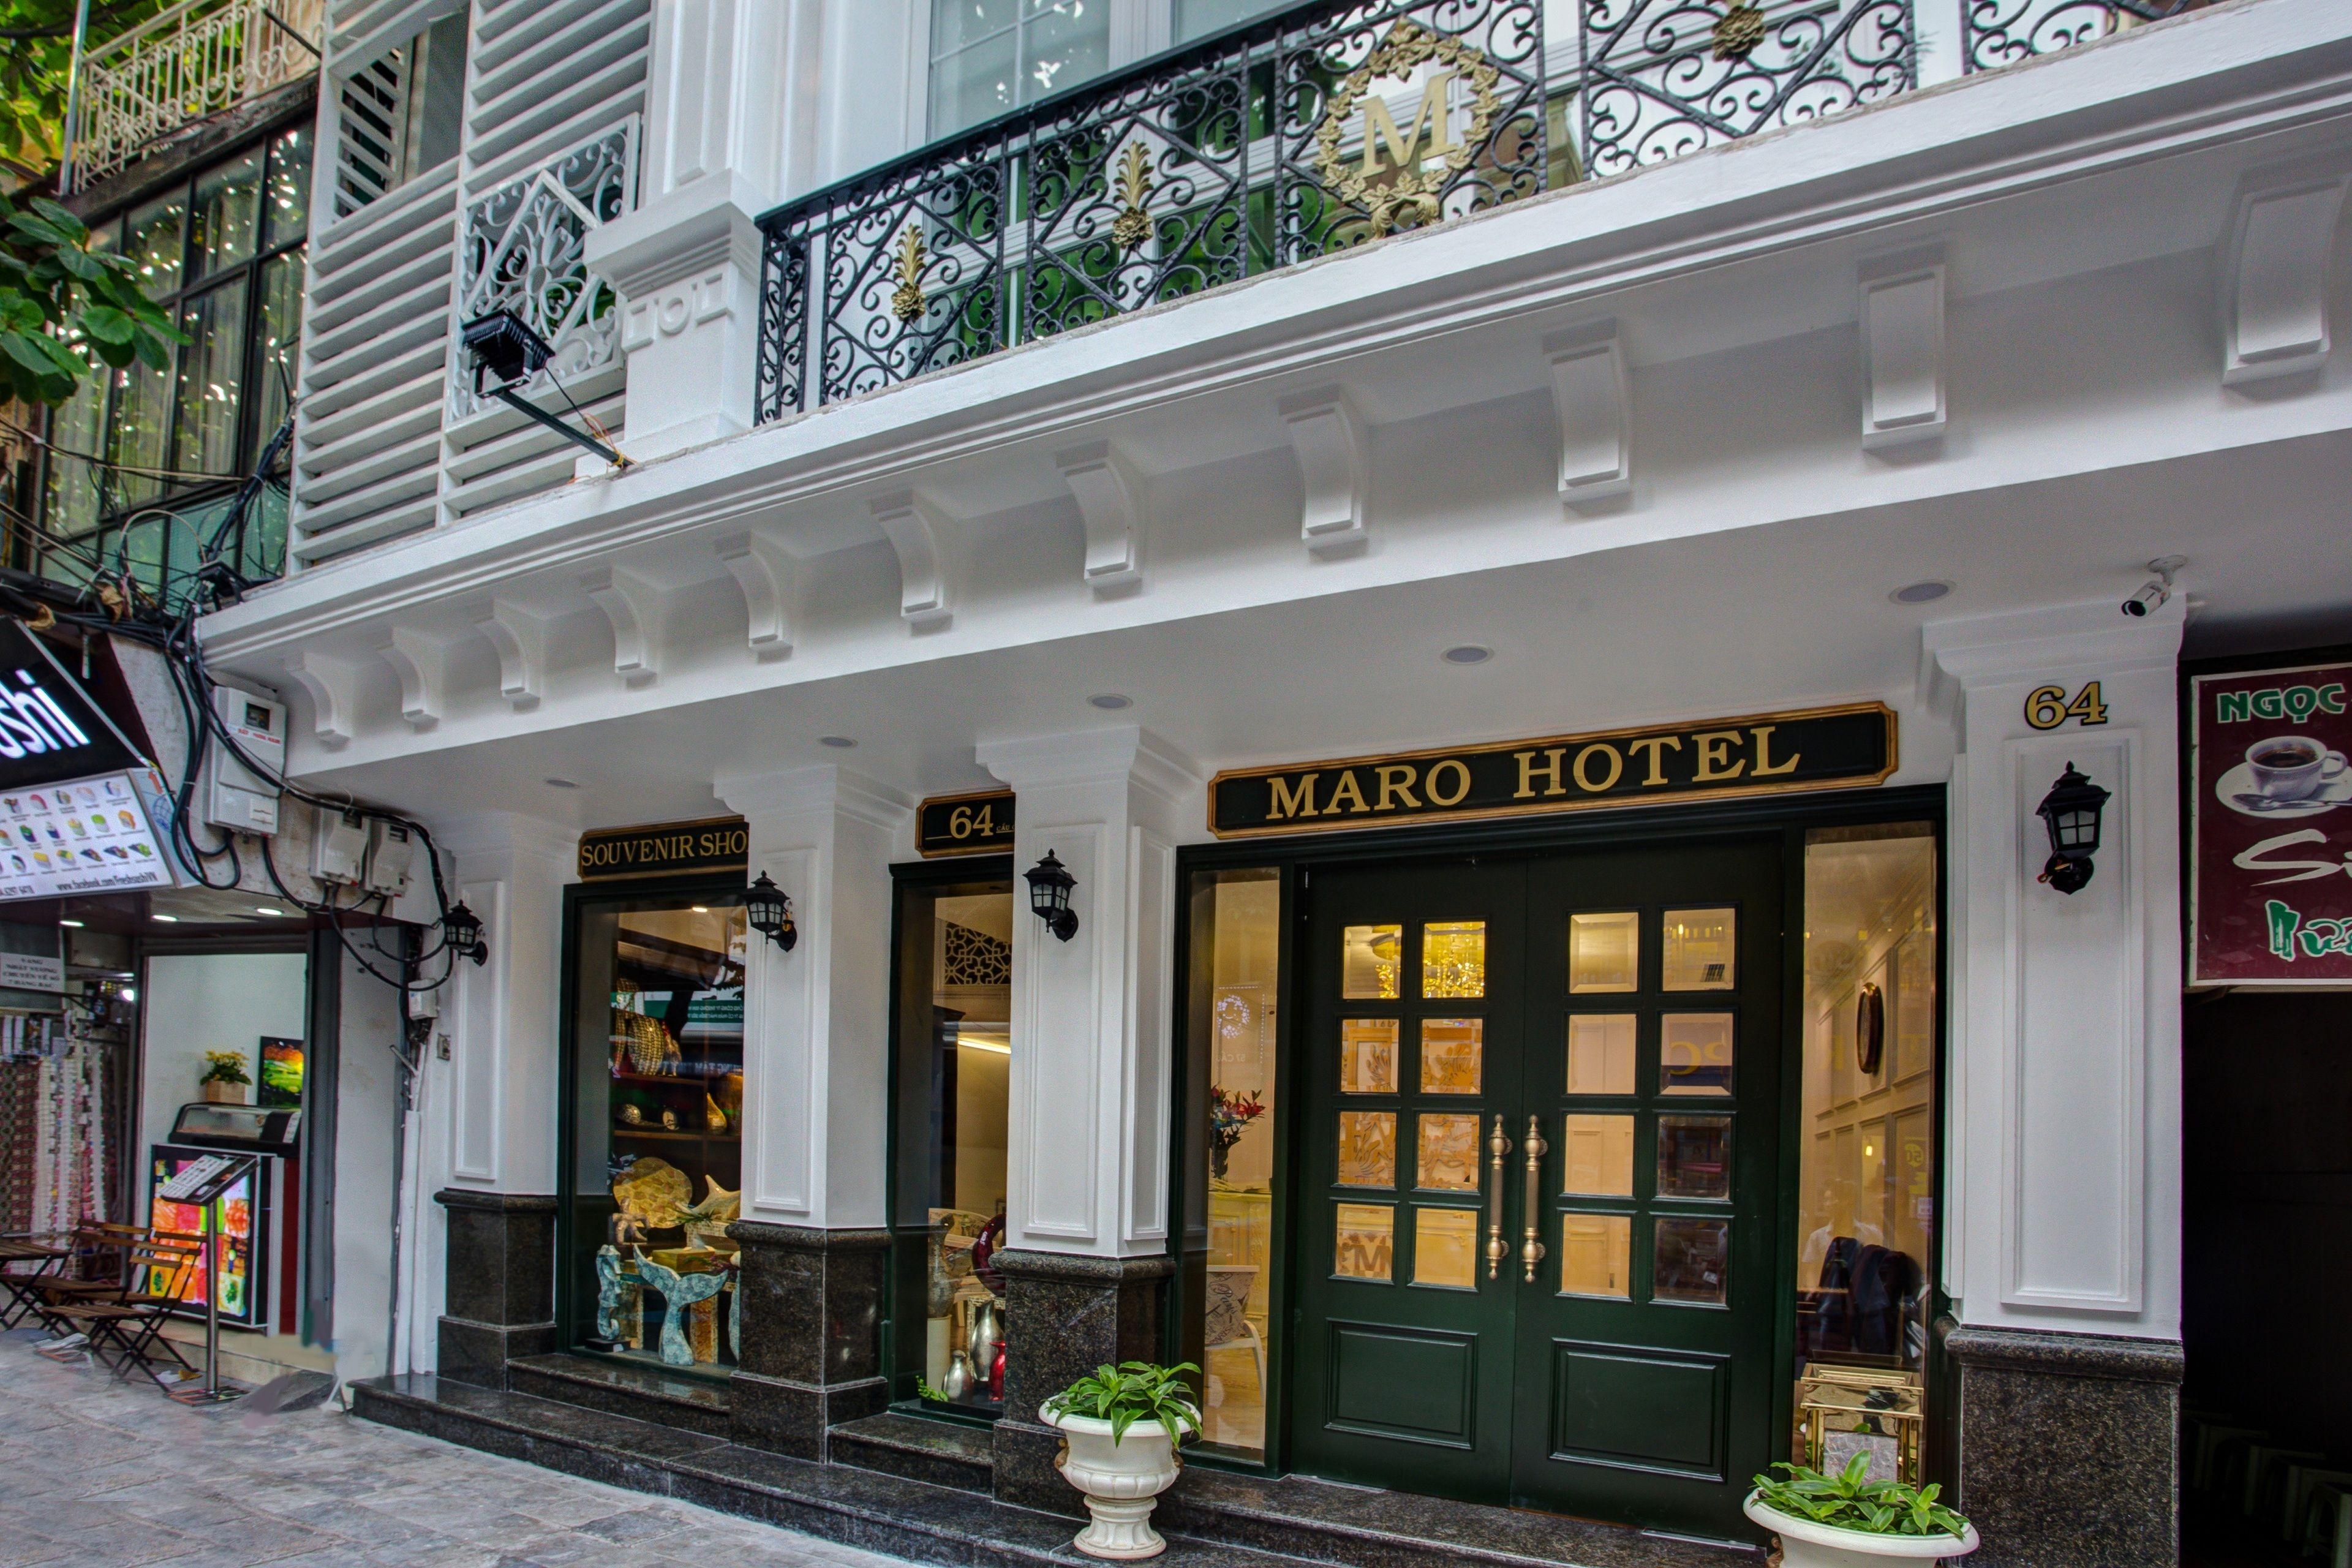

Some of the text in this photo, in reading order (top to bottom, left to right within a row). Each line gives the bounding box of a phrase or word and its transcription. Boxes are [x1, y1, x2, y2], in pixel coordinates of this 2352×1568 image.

[1352, 69, 1460, 180] M
[2024, 681, 2109, 730] 64
[2217, 683, 2346, 724] NGỌC
[1265, 726, 1801, 820] MARO HOTEL
[950, 805, 994, 839] 64
[581, 829, 748, 867] SOUVENIR SHO
